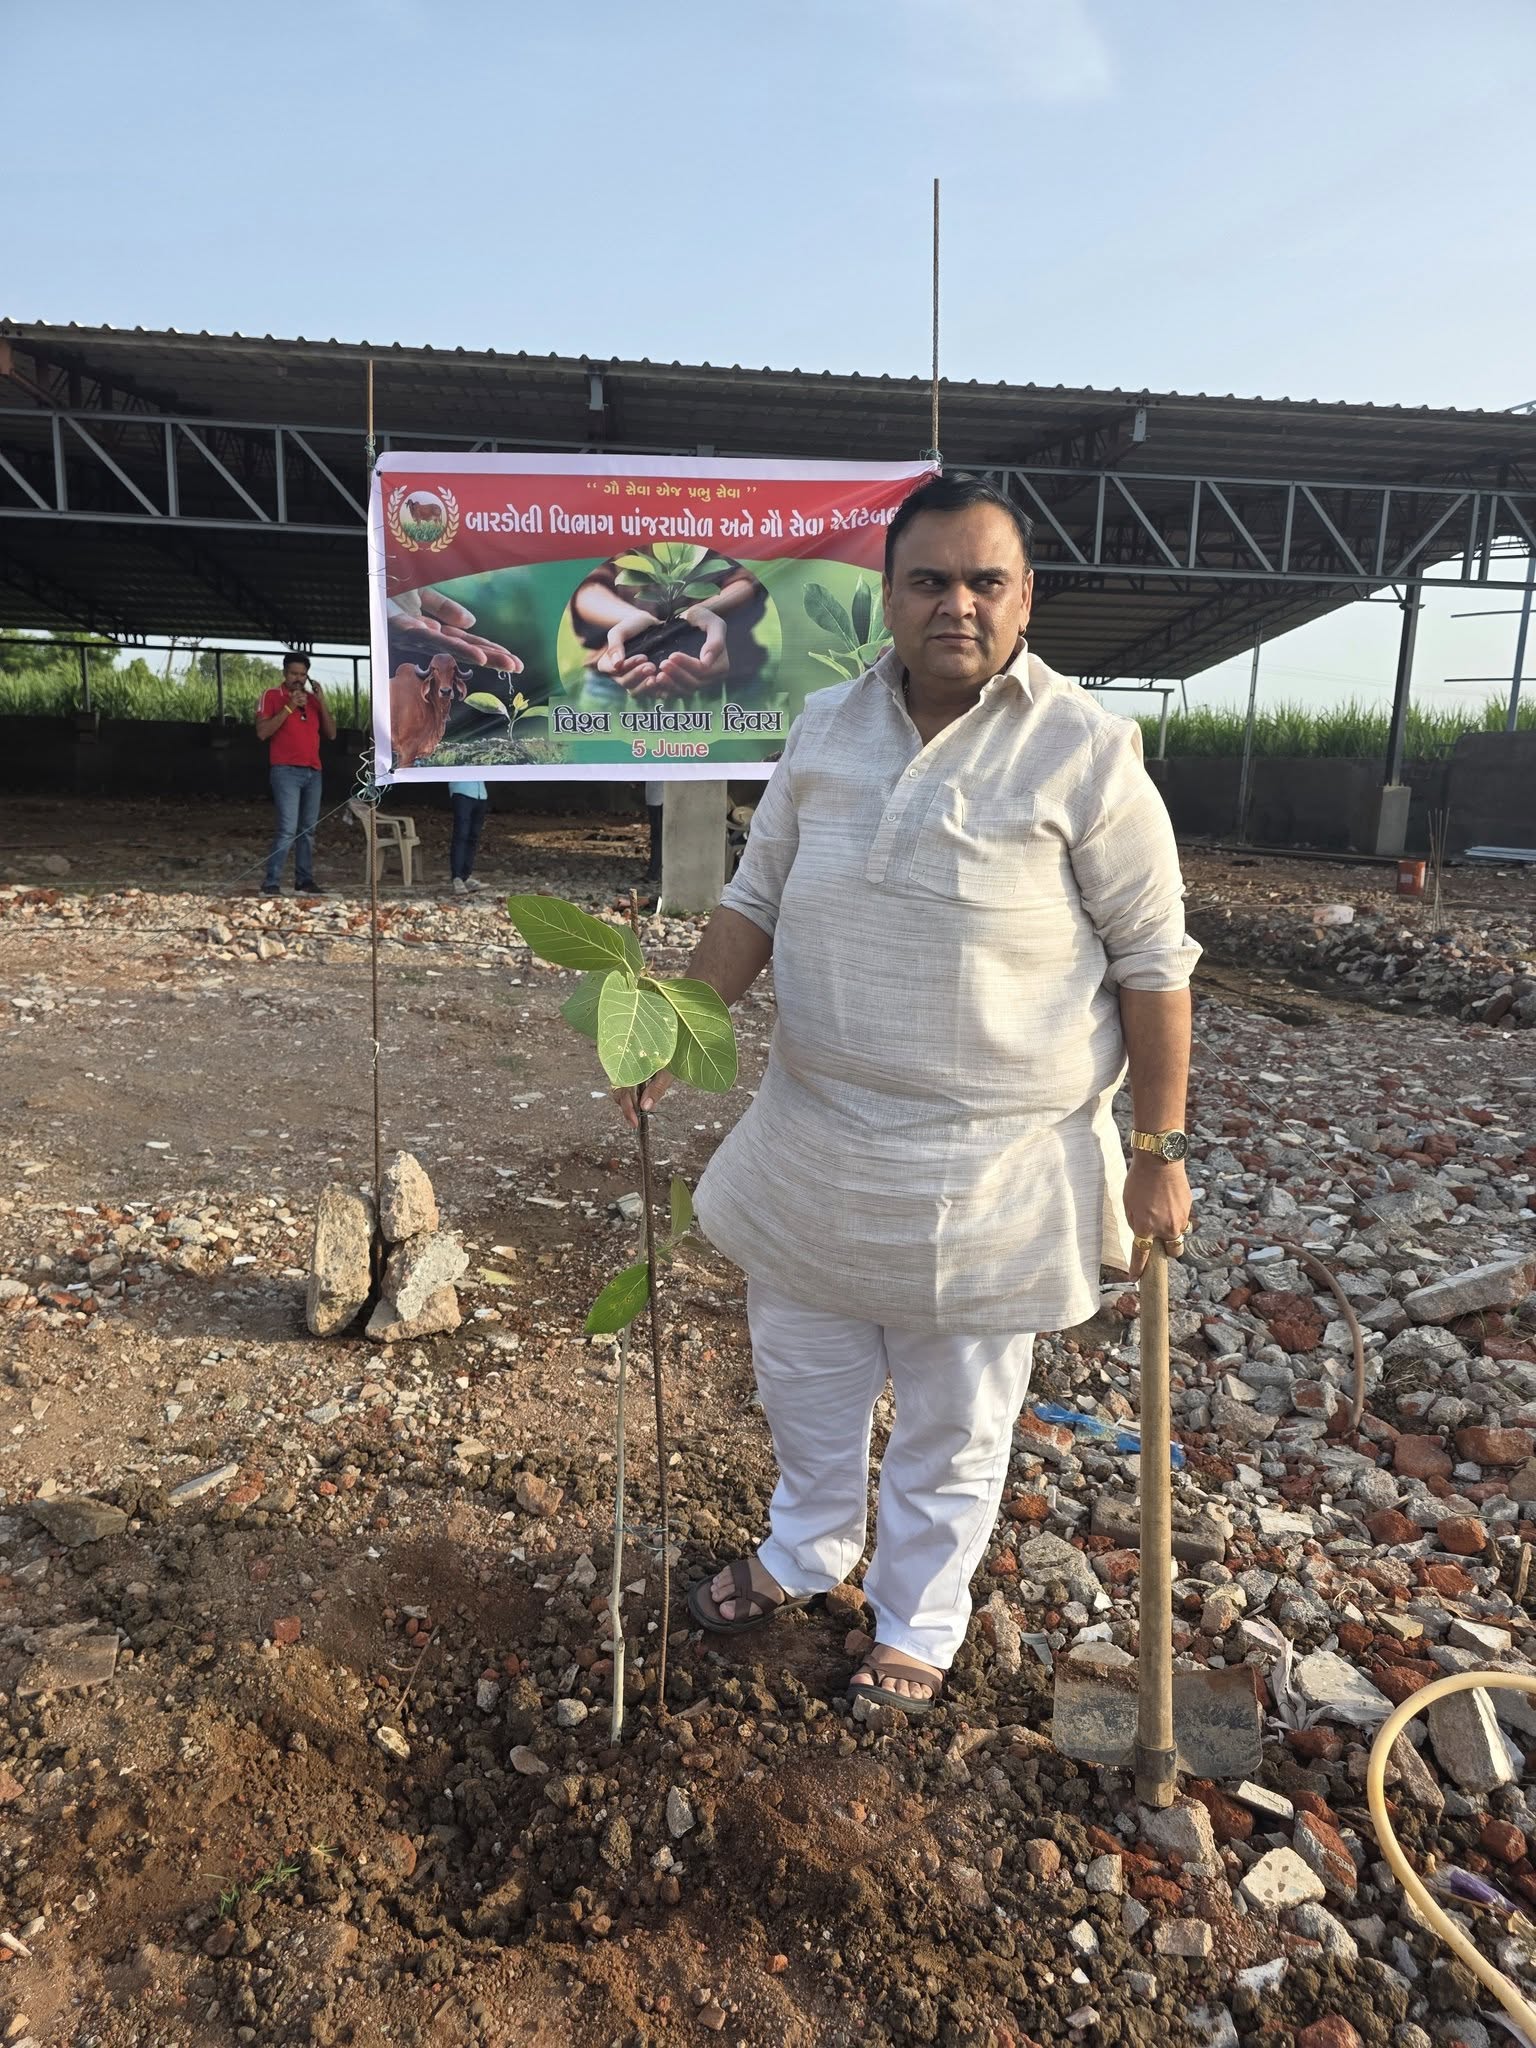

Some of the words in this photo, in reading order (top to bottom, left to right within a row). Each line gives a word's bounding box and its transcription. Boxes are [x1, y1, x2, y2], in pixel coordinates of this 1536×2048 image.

[603, 480, 619, 495] ગૌ
[625, 482, 650, 496] સેવા
[656, 483, 681, 497] એજ
[688, 487, 711, 502] પ્રભુ
[716, 484, 740, 498] સેવા
[464, 504, 543, 533] બારડોલી
[550, 505, 614, 535] વિભાગ
[620, 507, 713, 537] પાંજરાપોળ
[719, 509, 753, 537] અને
[759, 508, 782, 537] ગૌ
[789, 509, 824, 537] સેવા
[553, 704, 610, 733] विश्व
[620, 703, 711, 733] पर्यावरण
[721, 703, 783, 733] दिवस
[632, 739, 647, 757] 5
[652, 739, 709, 757] June
